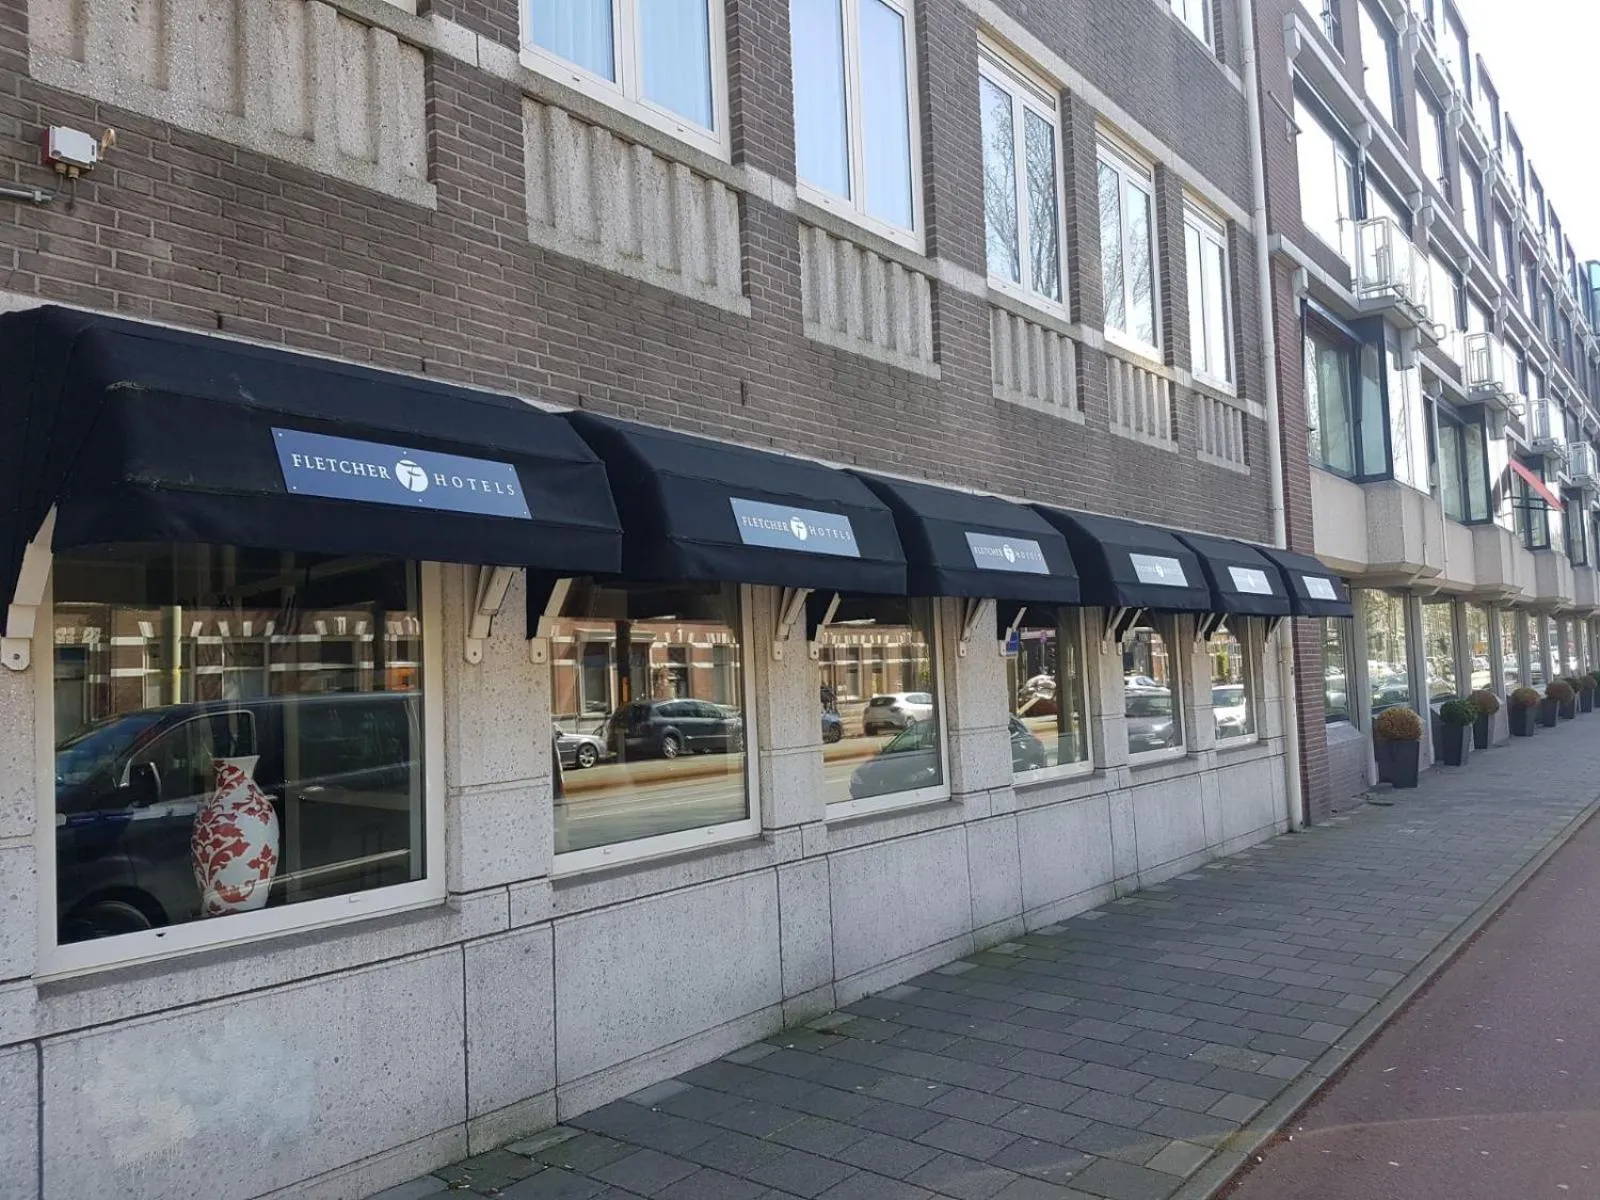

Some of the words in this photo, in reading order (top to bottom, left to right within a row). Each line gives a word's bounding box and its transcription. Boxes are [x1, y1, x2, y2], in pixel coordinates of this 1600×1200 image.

[291, 453, 391, 480] FLETCHER
[435, 473, 515, 497] HOTELS
[741, 516, 789, 532] FLETCHER
[809, 525, 851, 541] HOTELS
